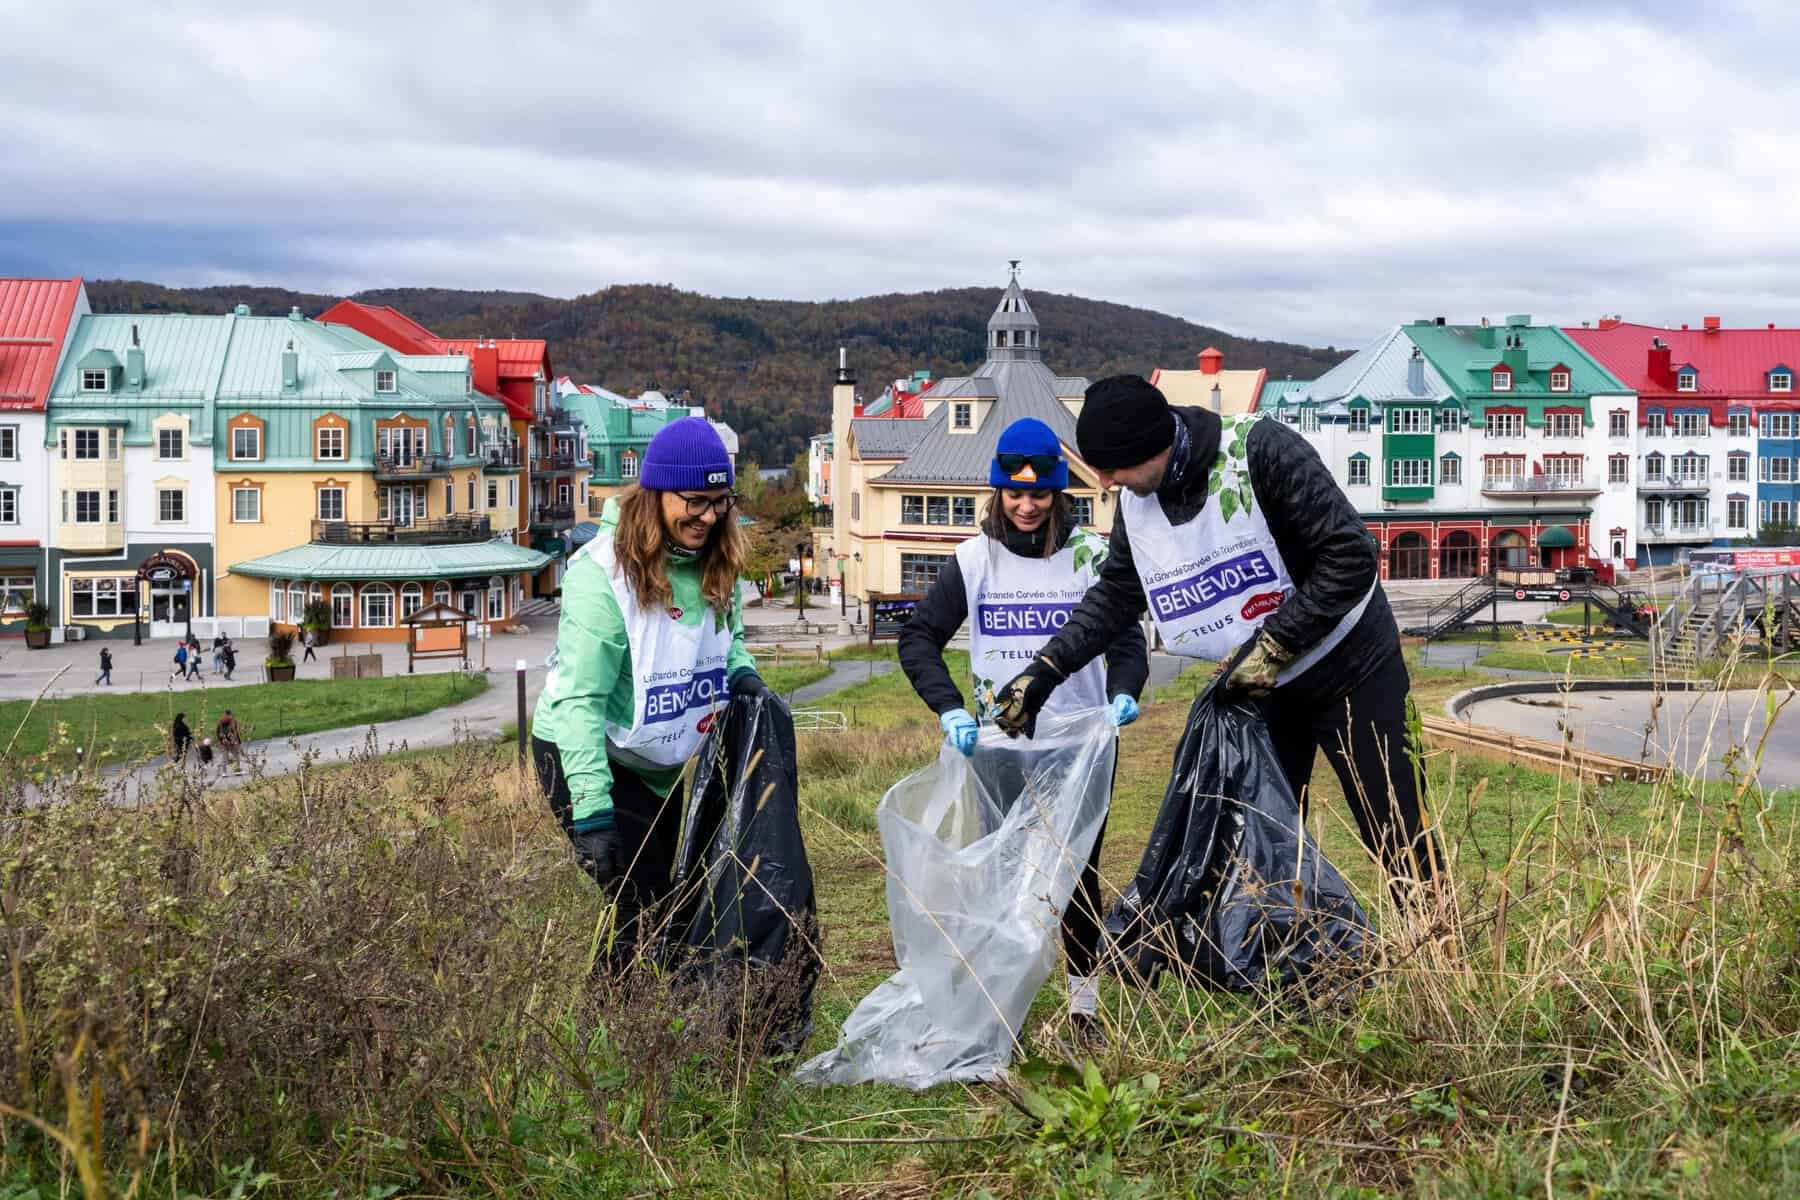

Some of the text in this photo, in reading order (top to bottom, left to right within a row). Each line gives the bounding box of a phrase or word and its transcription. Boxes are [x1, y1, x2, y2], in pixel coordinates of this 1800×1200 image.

[1156, 557, 1270, 615] BÉNÉVOLE
[984, 606, 1073, 630] BÉNÉVO
[1192, 614, 1234, 637] TELUS
